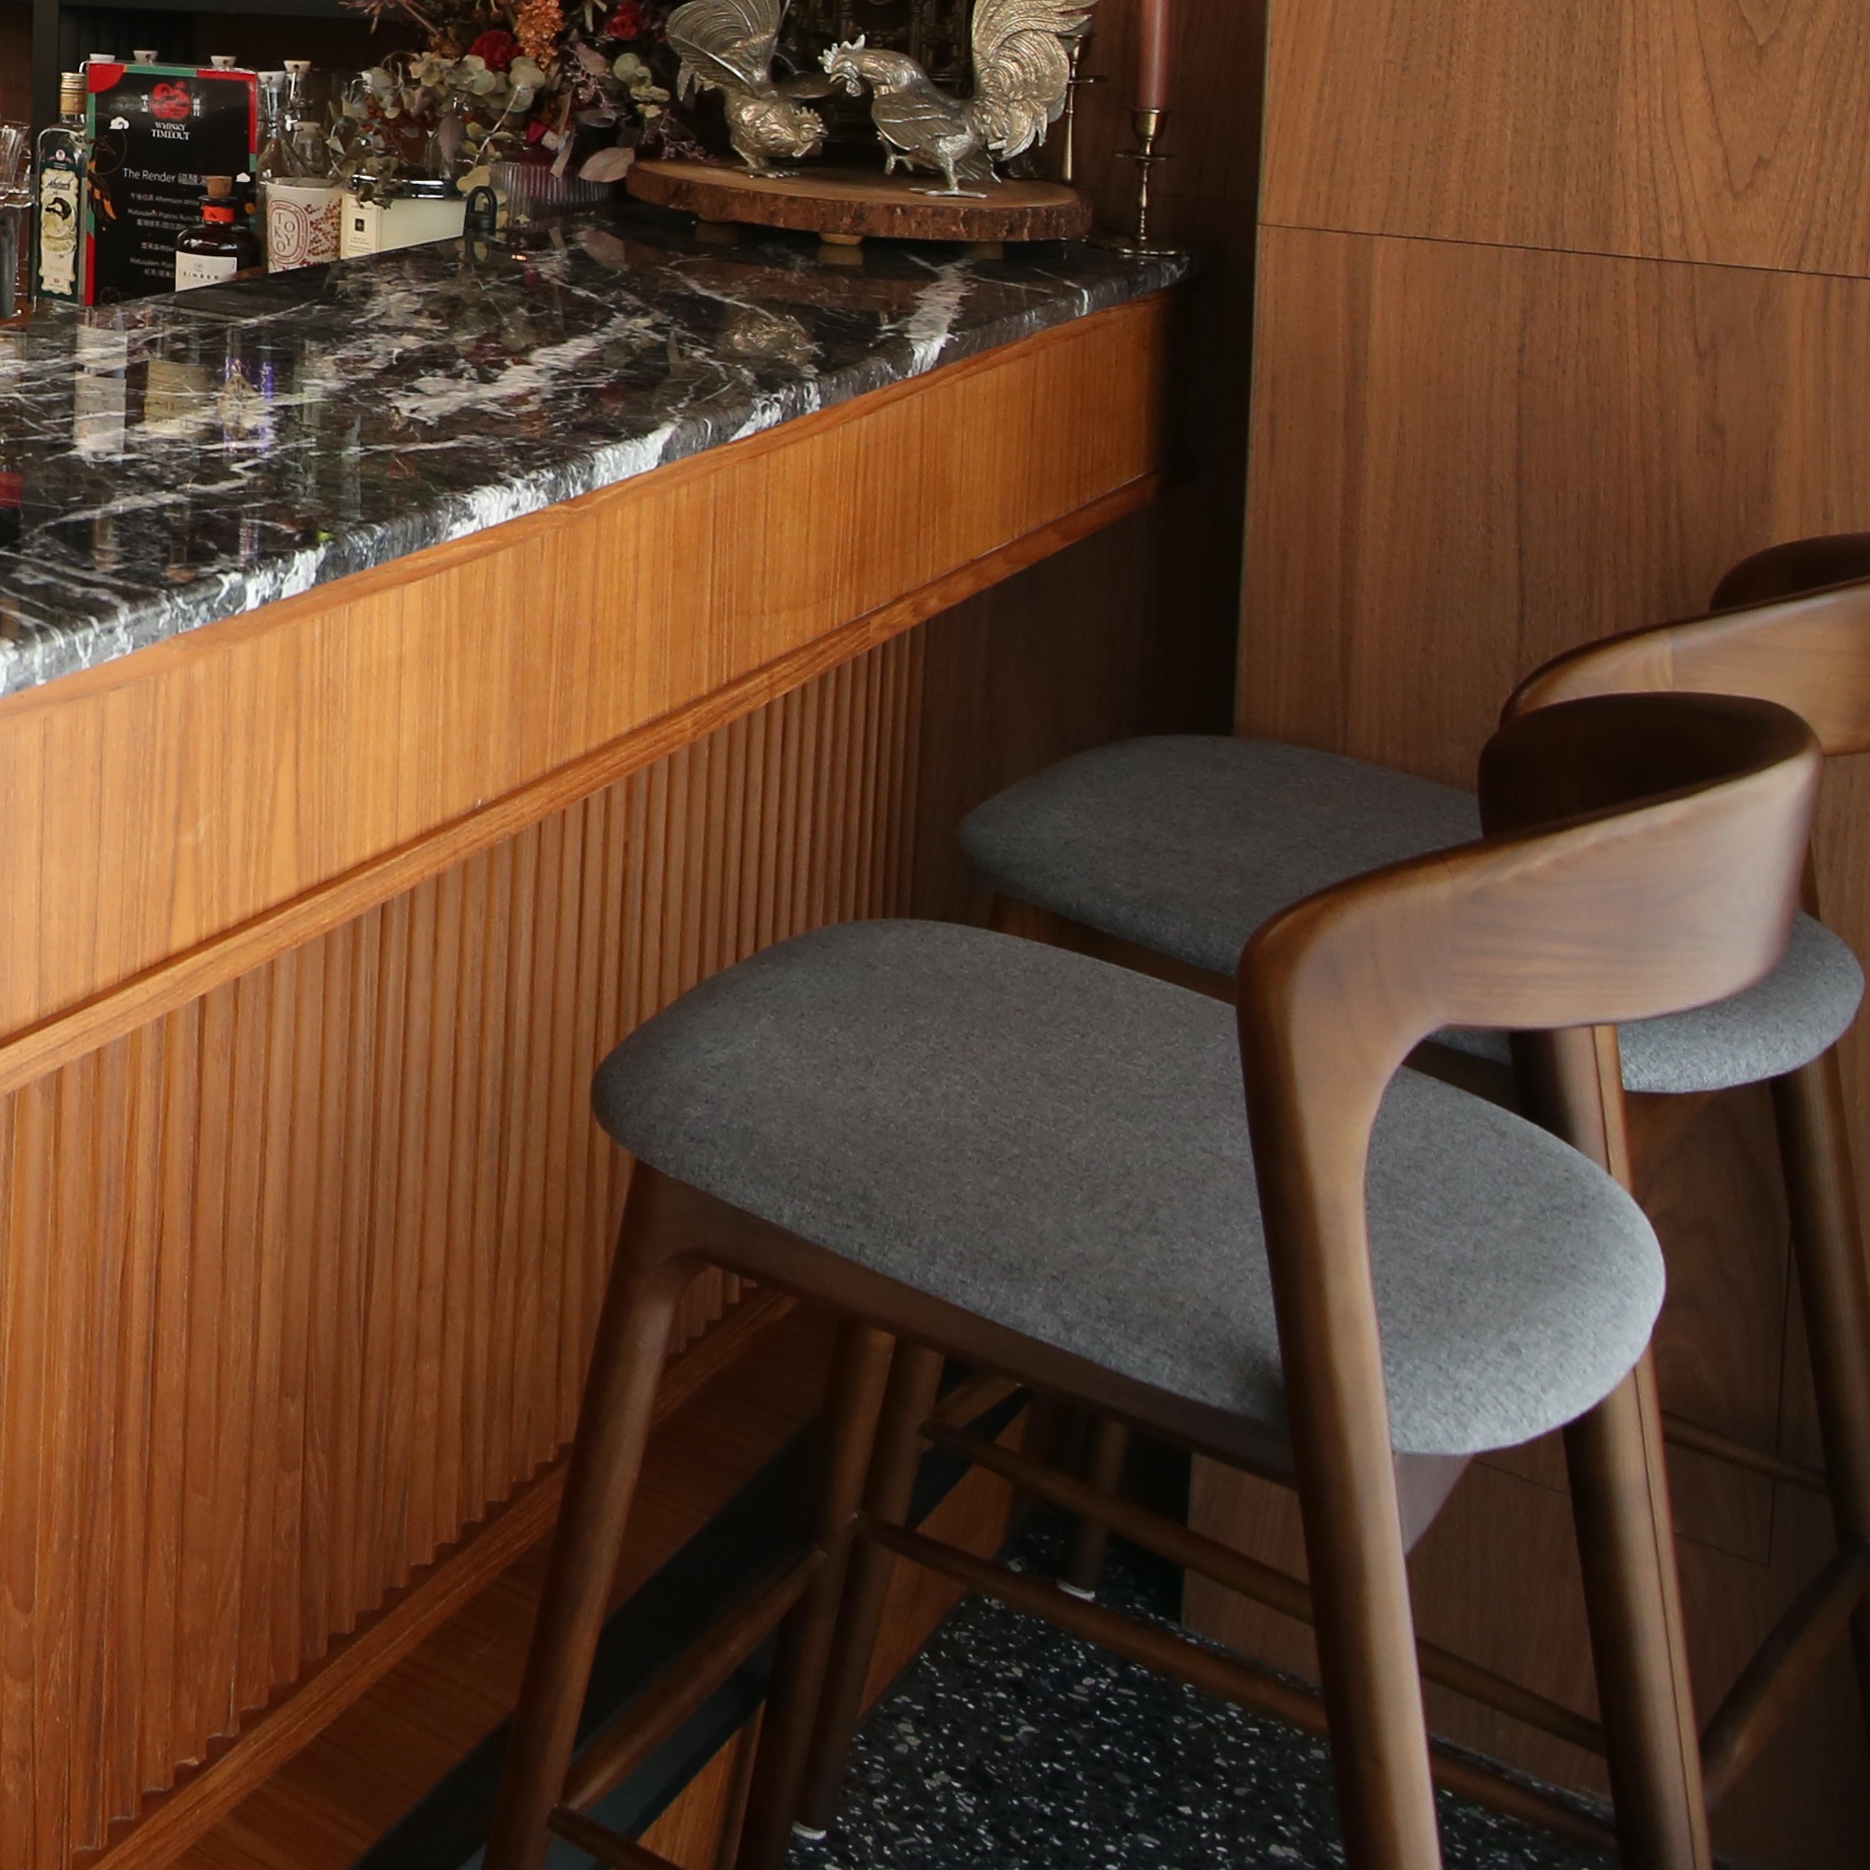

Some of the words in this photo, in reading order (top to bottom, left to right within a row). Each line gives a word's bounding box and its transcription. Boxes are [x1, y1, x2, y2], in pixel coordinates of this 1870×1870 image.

[151, 129, 191, 141] TIMEOUT
[123, 167, 141, 180] The
[141, 170, 176, 183] Render
